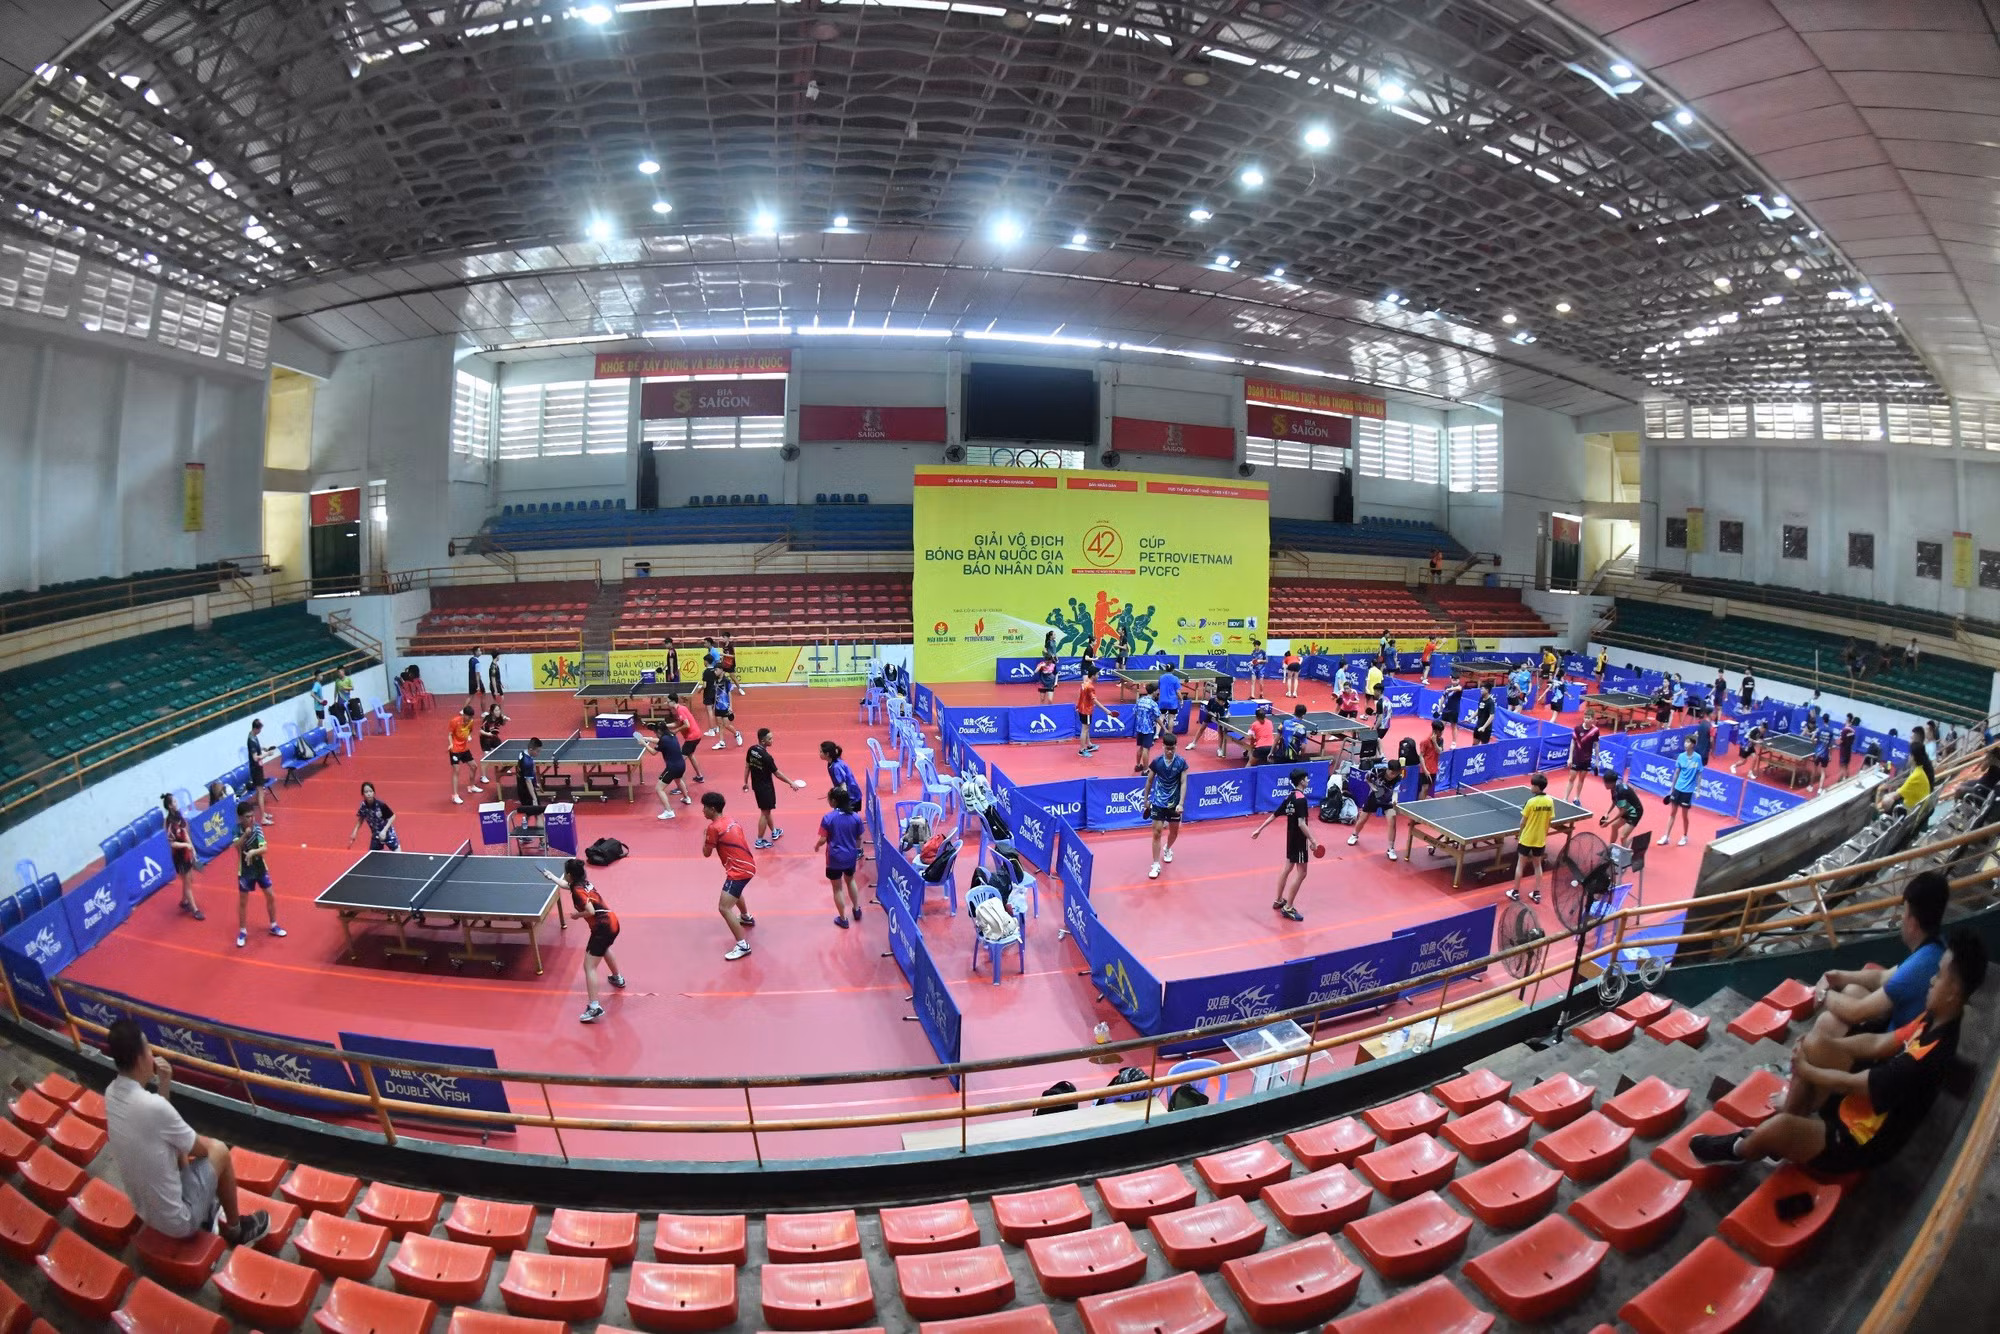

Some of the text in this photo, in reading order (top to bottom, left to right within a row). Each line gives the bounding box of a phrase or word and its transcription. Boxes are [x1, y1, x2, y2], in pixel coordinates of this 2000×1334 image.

[600, 359, 625, 373] KHỎE
[663, 358, 688, 372] DỰNG
[757, 353, 783, 368] QUỐC
[699, 396, 750, 409] SAIGON
[1291, 423, 1329, 438] SAIGON
[974, 531, 1064, 548] GIẢI VÔ ĐỊCH
[1087, 531, 1115, 558] 42
[1139, 535, 1166, 549] CÚP
[925, 545, 1064, 561] BÓNG BÀN QUỐC GIA
[1139, 552, 1233, 565] PETROVIETNAM
[963, 561, 991, 575] BÁO
[994, 561, 1033, 575] NHÂN
[1036, 561, 1064, 575] DÂN
[1139, 566, 1180, 577] PVCFC
[615, 660, 632, 668] GIẢI
[633, 660, 644, 668] VÔ
[682, 661, 695, 674] 42
[613, 669, 628, 677] BÀN
[958, 726, 980, 734] DOUBLE
[1271, 788, 1290, 798] DOUBL
[1199, 794, 1243, 807] DOUBLE FISH
[1105, 805, 1132, 815] DOUBLE
[1410, 949, 1469, 975] DOUBLE FISH
[1319, 971, 1341, 987] 双魚
[1307, 979, 1381, 1004] DOUBLE FISH
[1206, 995, 1230, 1012] 双魚
[1195, 1006, 1277, 1028] DOUBLE FISH
[385, 1080, 471, 1103] DOUBLE FISH
